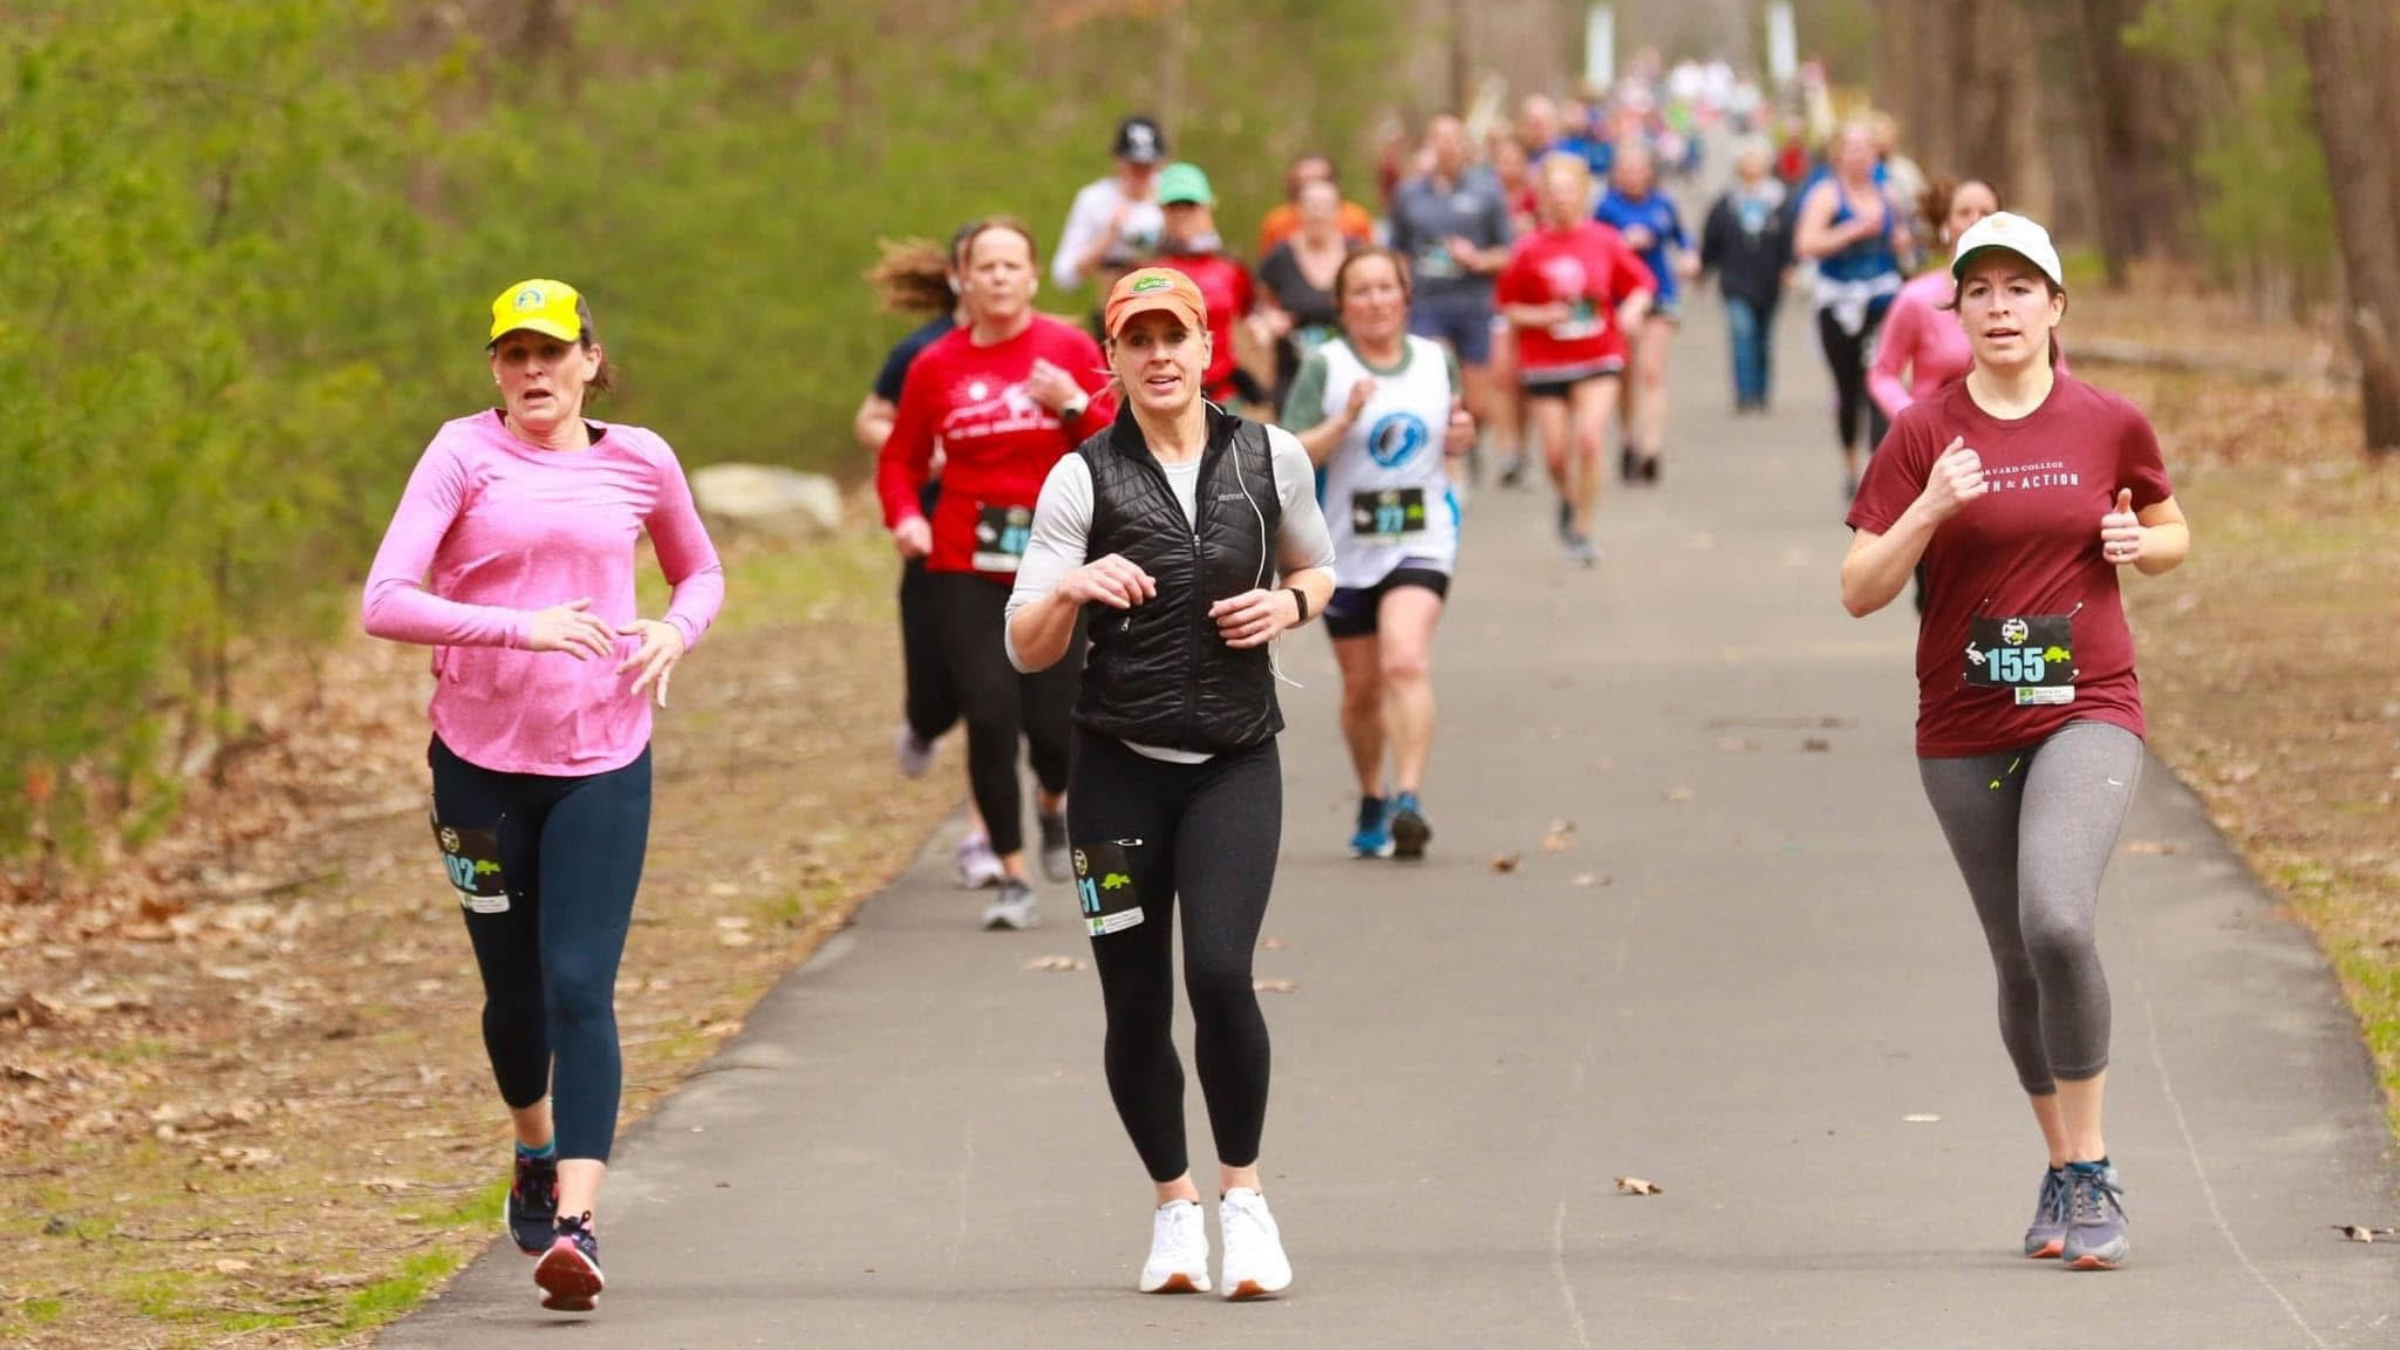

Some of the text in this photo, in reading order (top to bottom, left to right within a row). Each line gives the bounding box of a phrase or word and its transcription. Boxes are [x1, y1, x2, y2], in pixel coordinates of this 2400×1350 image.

[2020, 462, 2063, 472] COLLEGE
[2006, 480, 2016, 489] &
[2022, 474, 2079, 489] ACTION
[1985, 647, 2045, 682] 155
